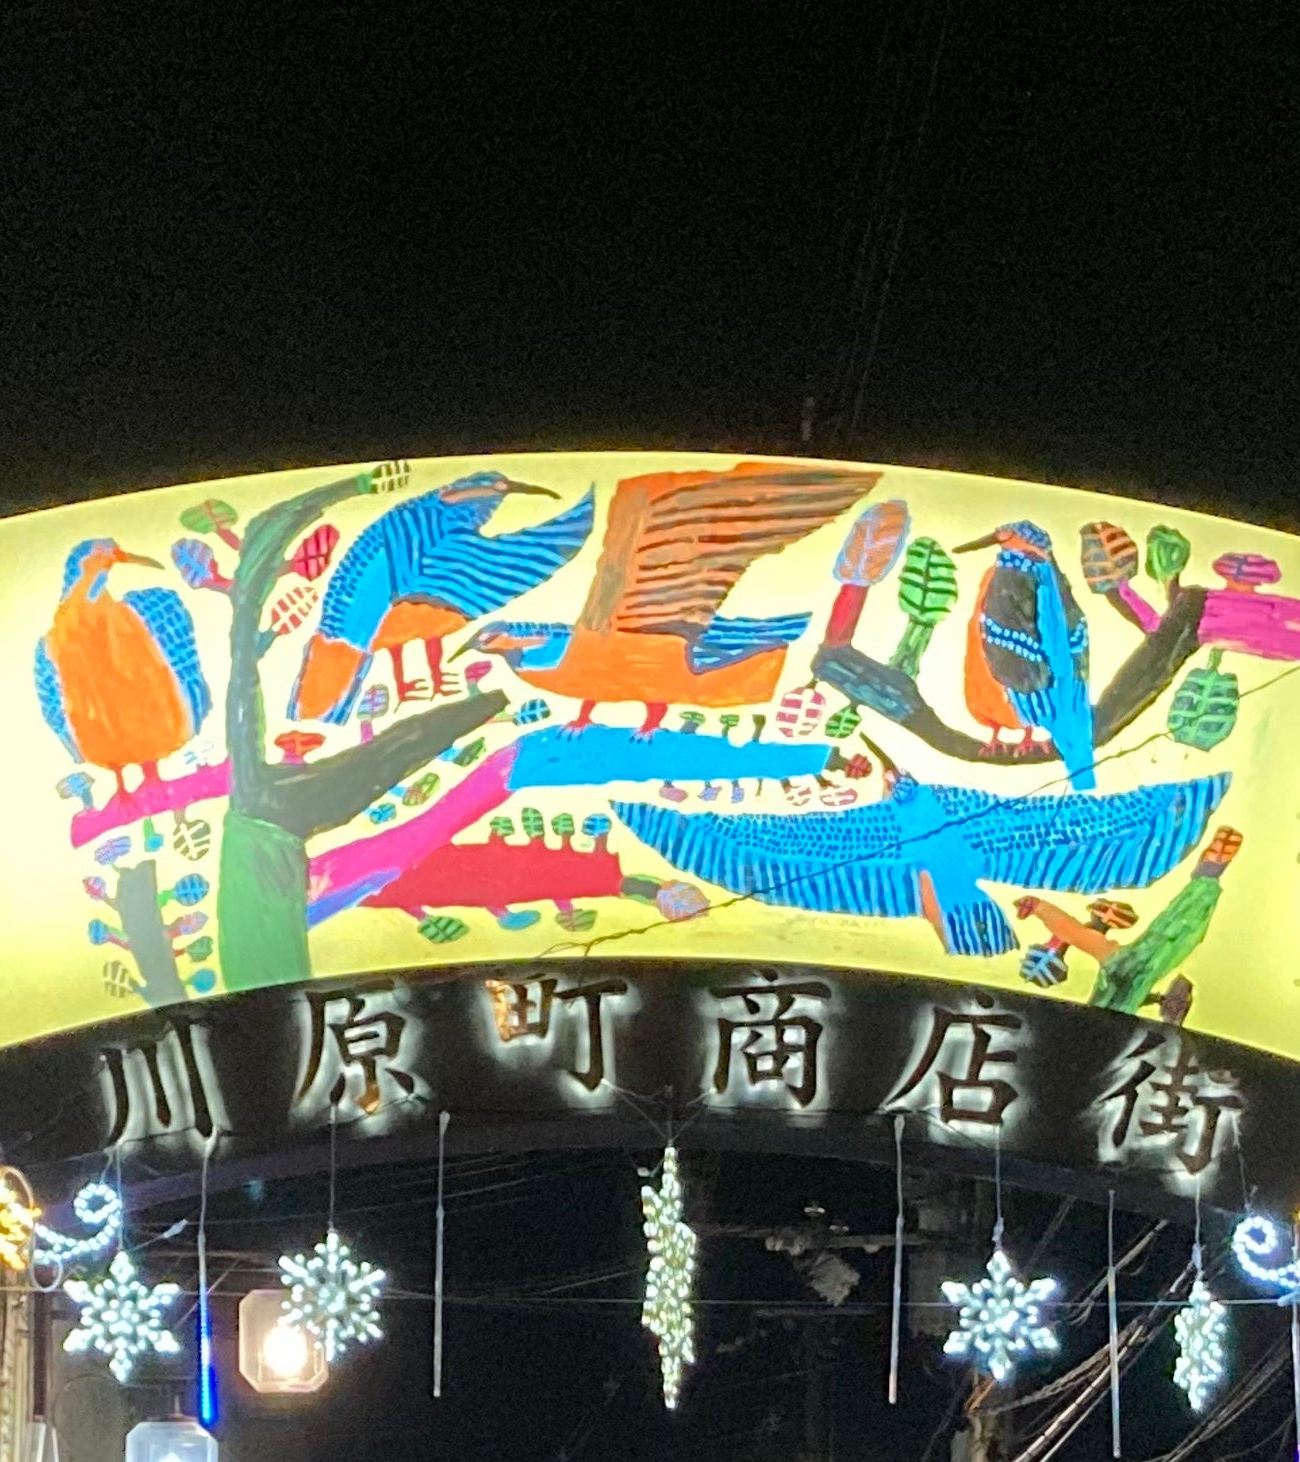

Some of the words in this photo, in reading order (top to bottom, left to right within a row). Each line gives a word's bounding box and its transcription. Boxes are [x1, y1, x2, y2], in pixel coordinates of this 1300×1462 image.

[102, 970, 1246, 1174] 川原町商店街
